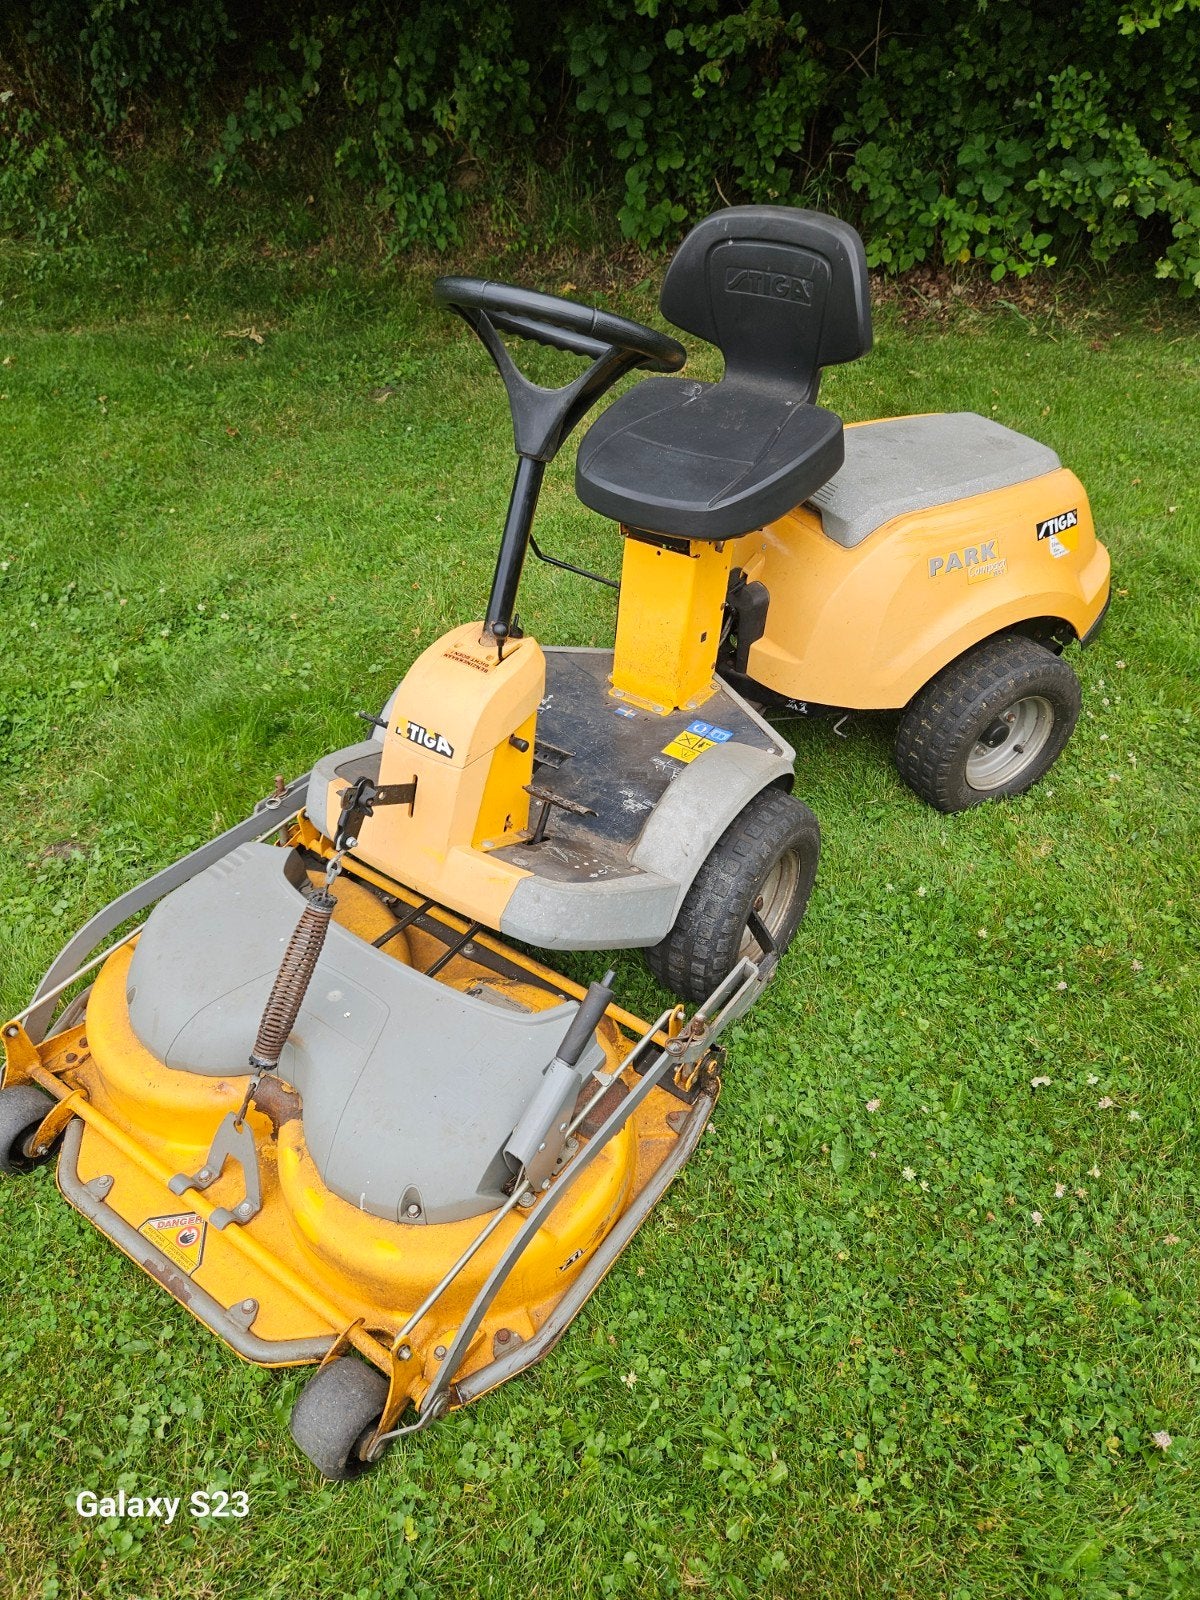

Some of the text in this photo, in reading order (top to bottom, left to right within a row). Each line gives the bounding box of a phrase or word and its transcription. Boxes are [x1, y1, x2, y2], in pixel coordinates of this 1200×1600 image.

[727, 268, 810, 304] STIGA
[1038, 511, 1077, 540] STIGA
[929, 540, 996, 577] PARK
[157, 1215, 204, 1229] DANGER
